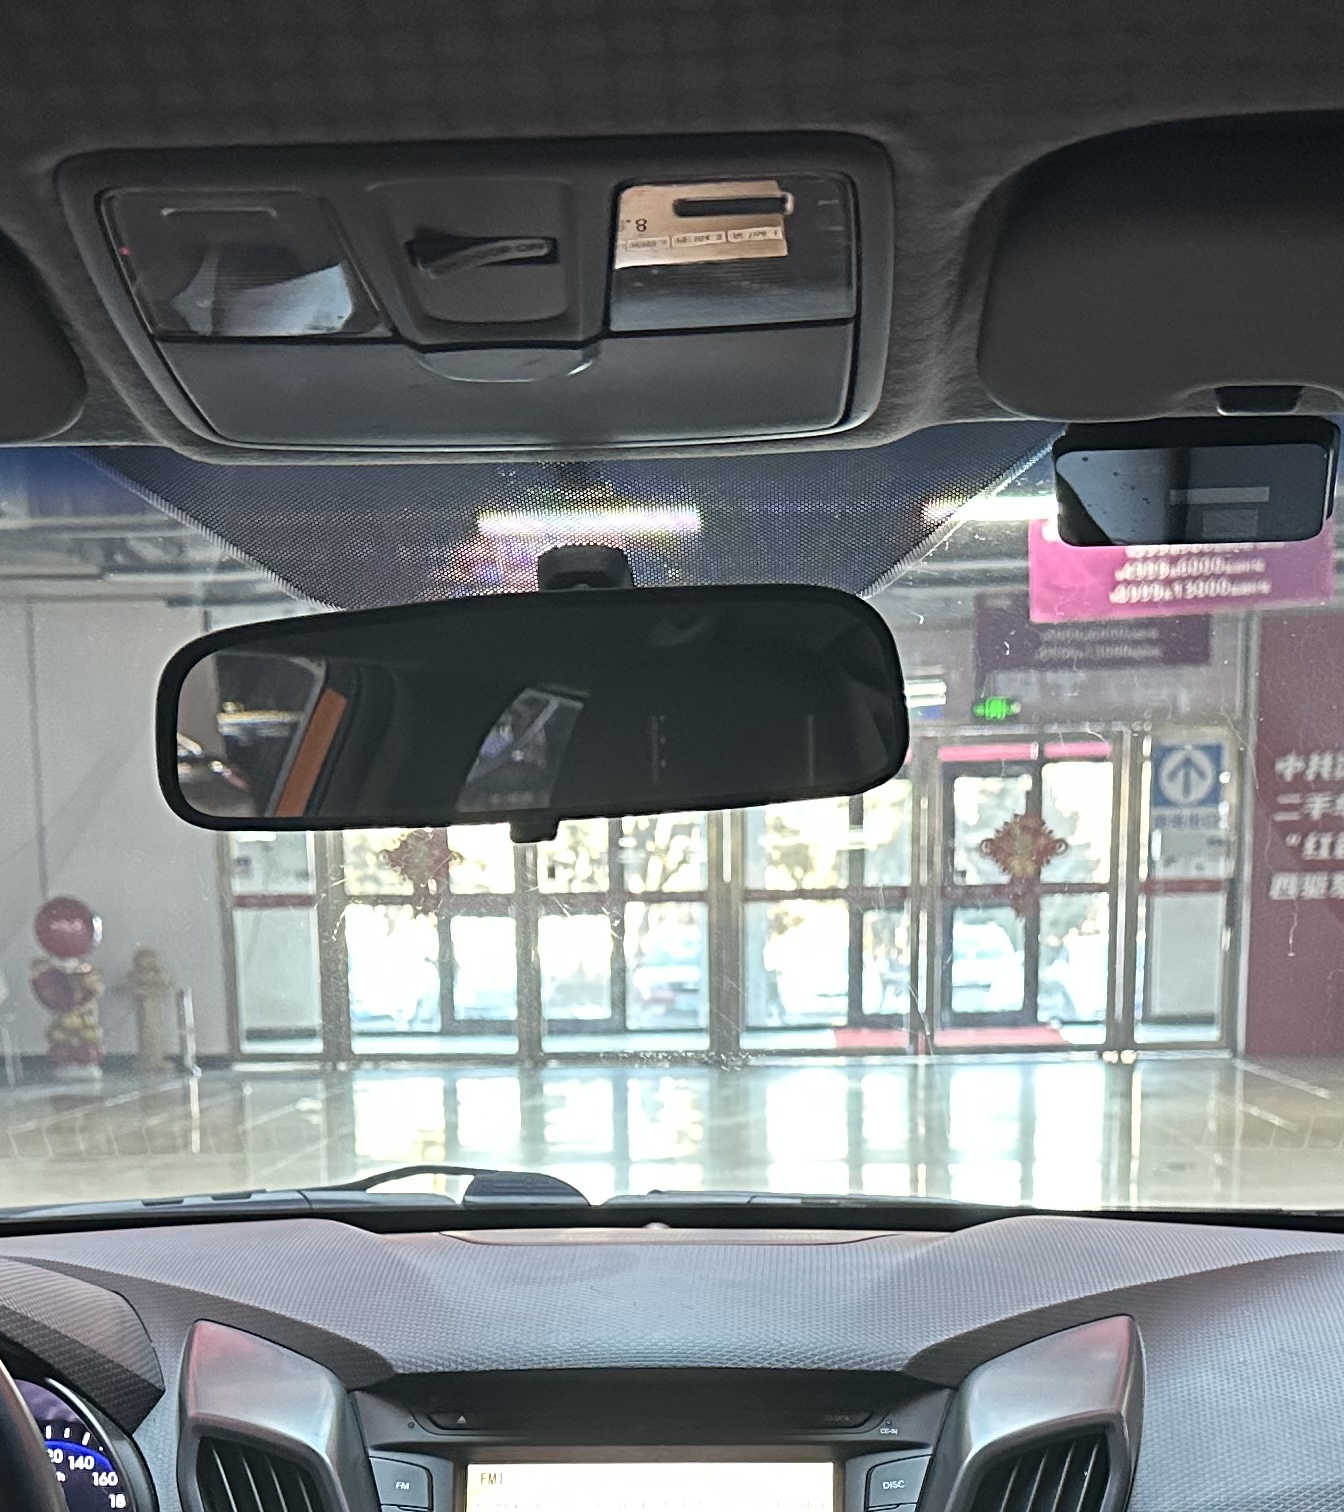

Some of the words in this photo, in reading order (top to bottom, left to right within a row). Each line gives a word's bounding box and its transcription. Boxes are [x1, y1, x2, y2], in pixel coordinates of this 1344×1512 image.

[68, 1455, 94, 1470] 140
[92, 1471, 118, 1486] 160
[480, 1472, 503, 1485] FM1
[882, 1479, 905, 1490] DISC
[395, 1481, 410, 1490] FM
